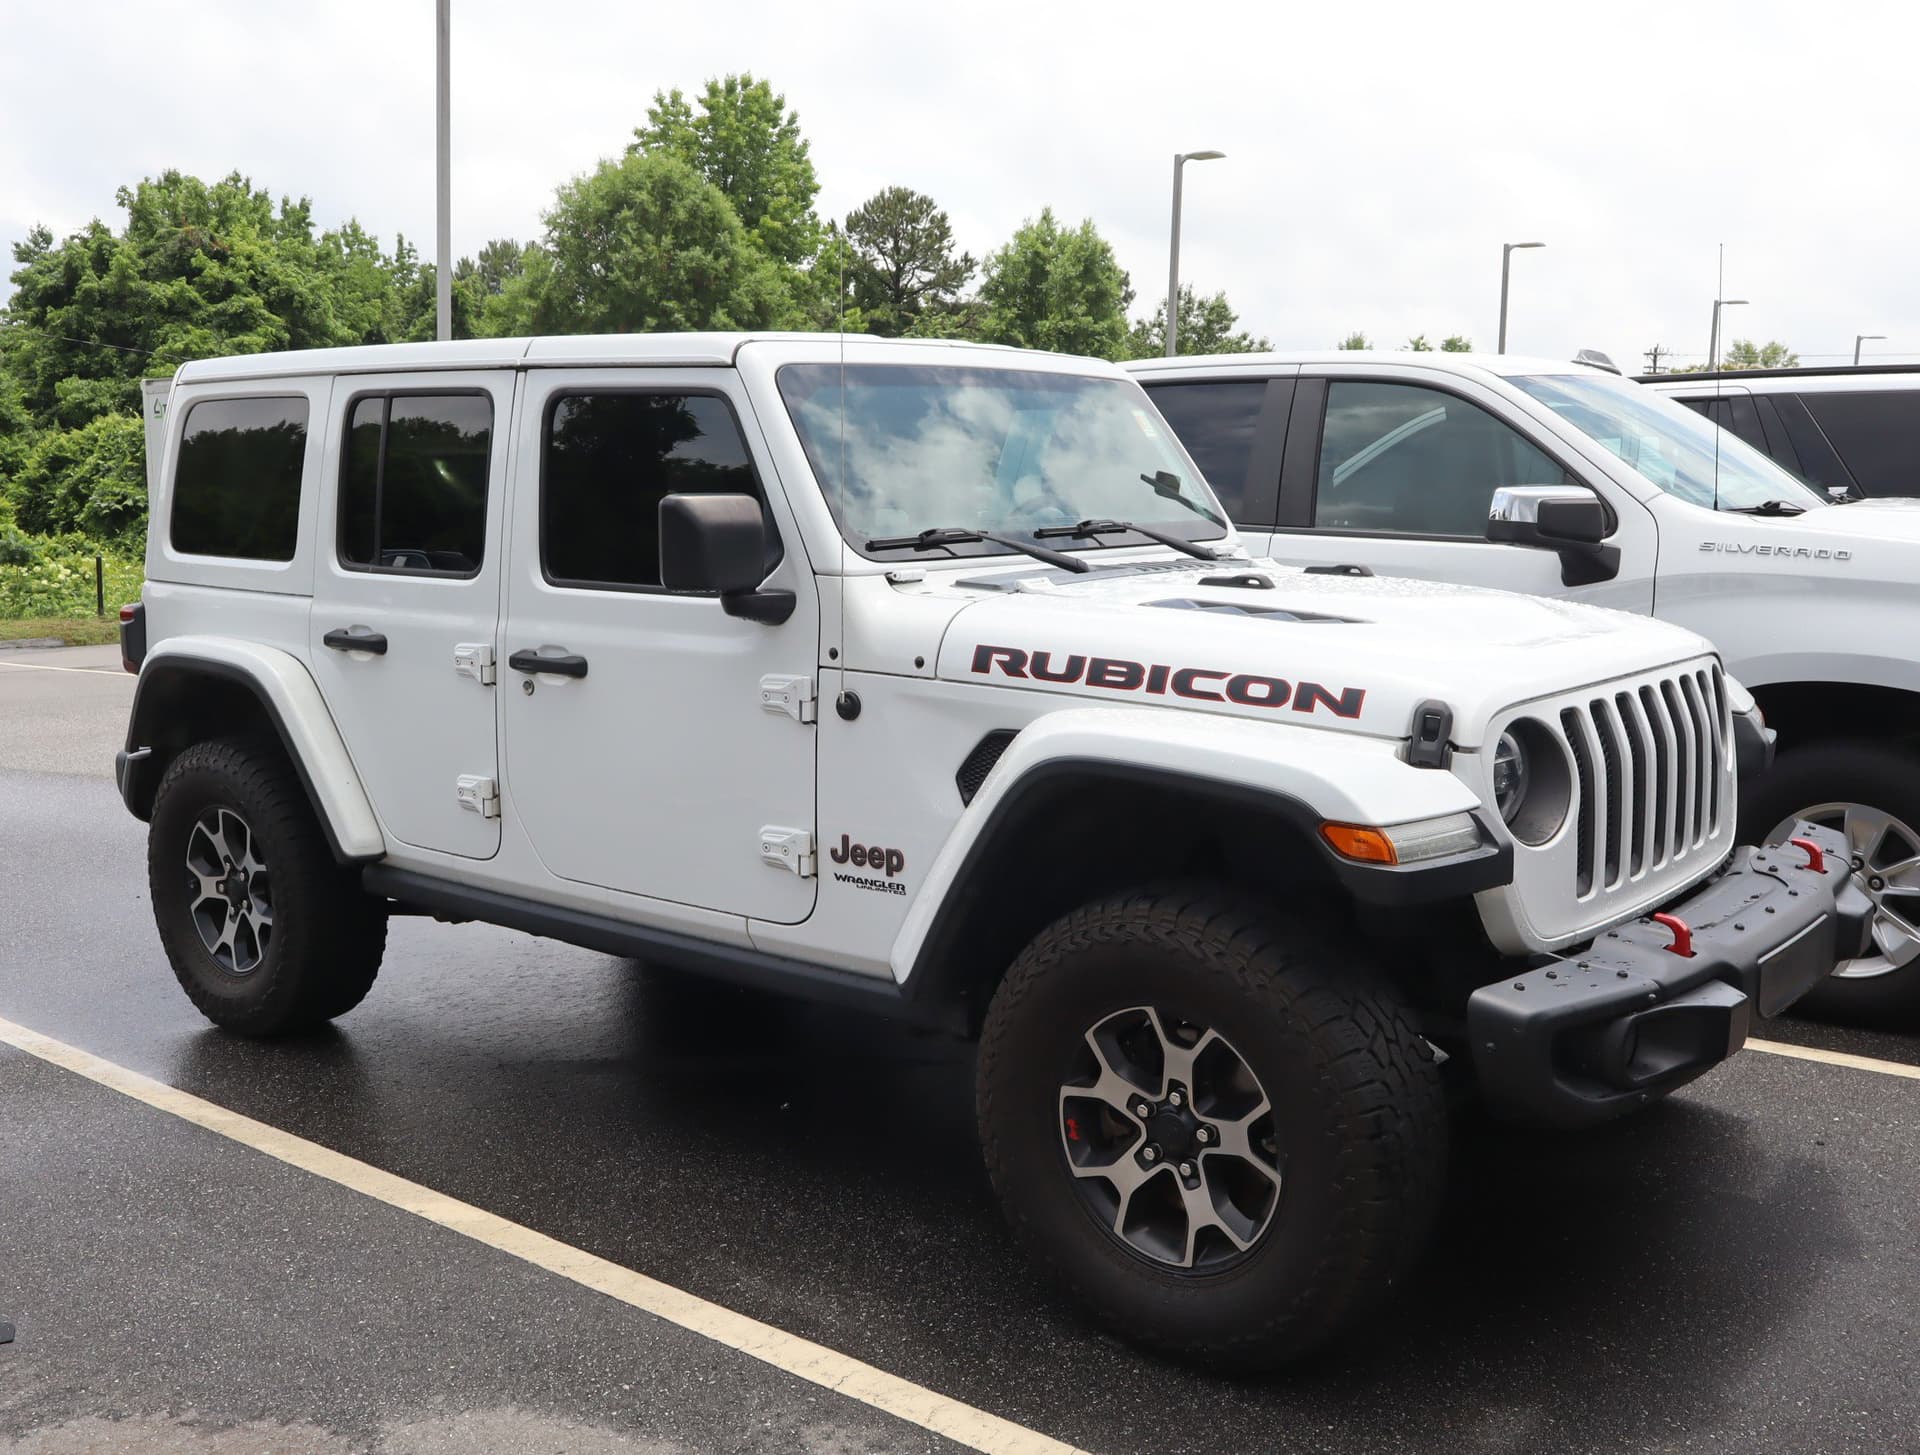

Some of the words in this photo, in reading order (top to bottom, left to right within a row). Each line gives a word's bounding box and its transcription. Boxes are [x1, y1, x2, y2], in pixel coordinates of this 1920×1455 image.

[1698, 541, 1853, 561] SILVERADO
[970, 644, 1366, 720] RUBICON
[830, 833, 905, 877] Jeep
[833, 872, 906, 892] WRANGLER
[856, 884, 907, 896] UNLIMITED
